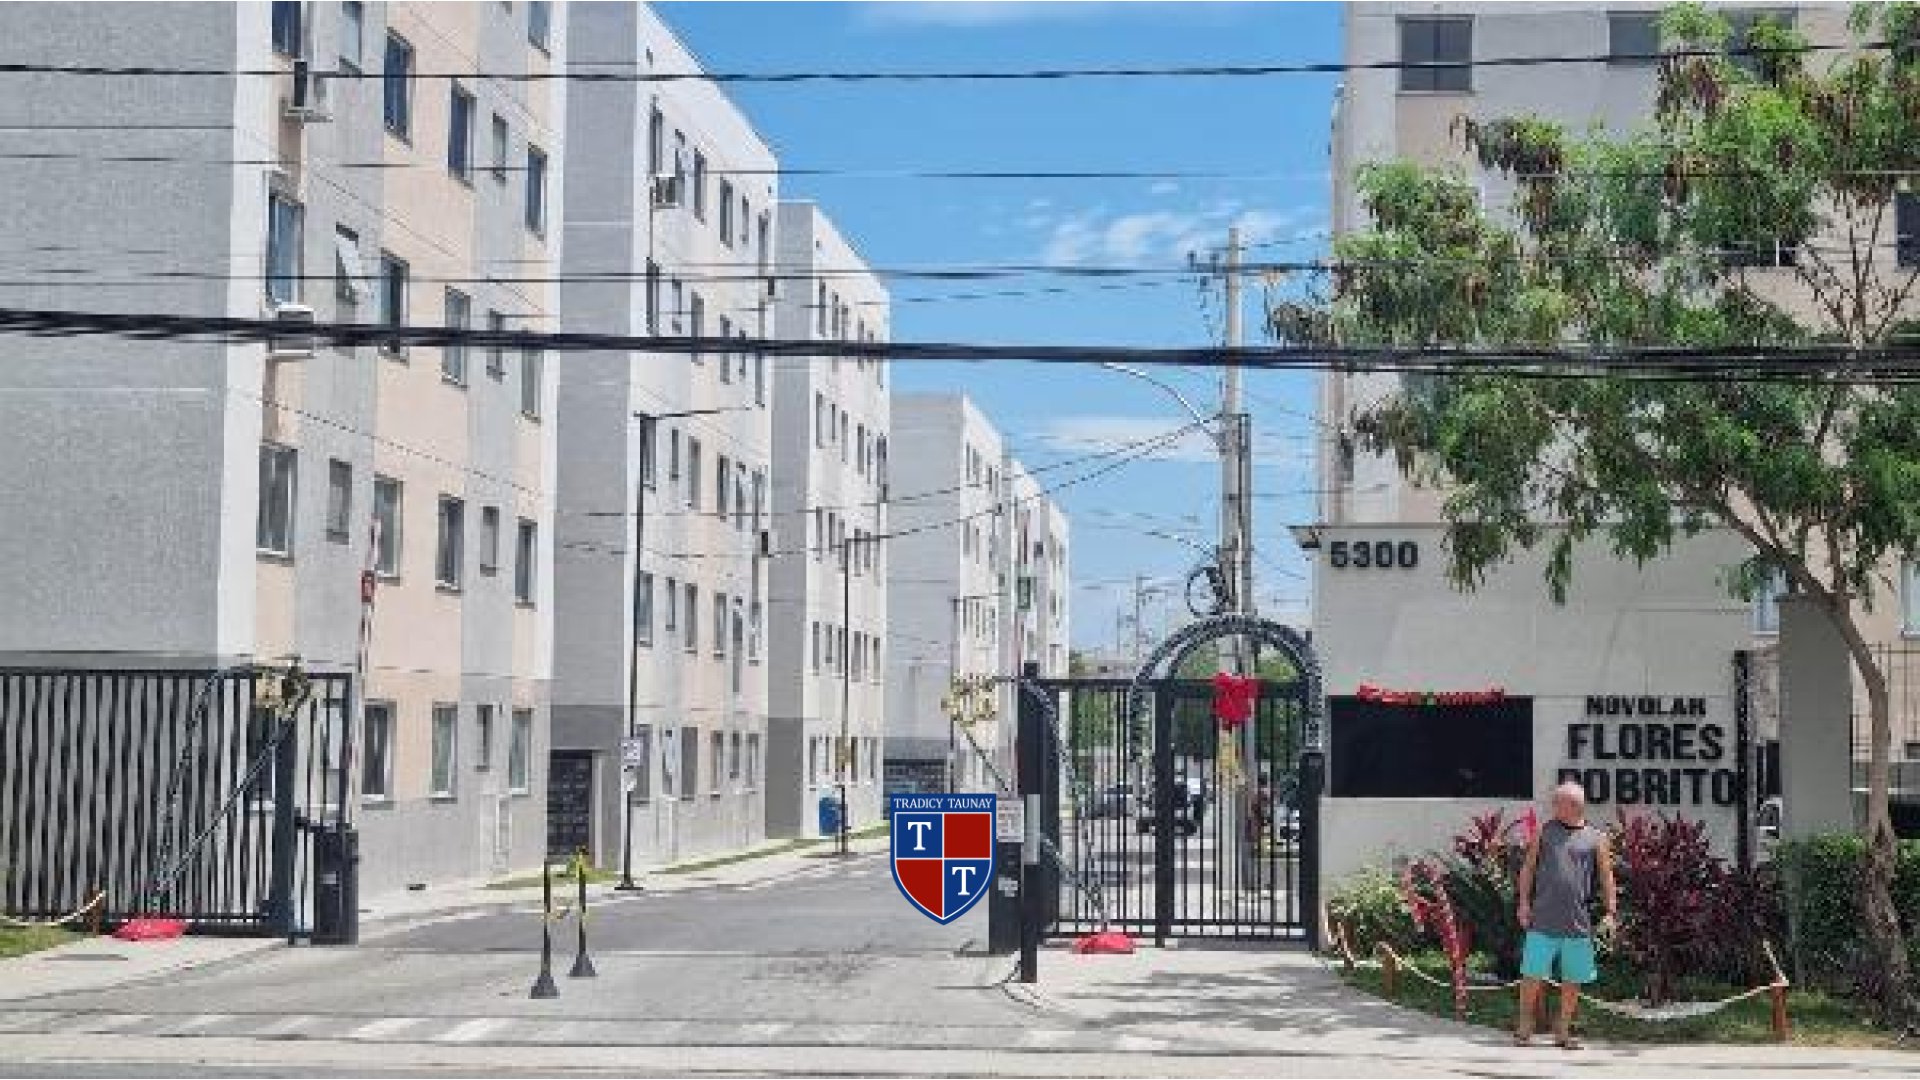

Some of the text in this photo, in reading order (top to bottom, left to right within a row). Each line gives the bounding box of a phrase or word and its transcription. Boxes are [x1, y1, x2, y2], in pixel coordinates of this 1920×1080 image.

[1331, 541, 1418, 568] 5300
[1586, 695, 1706, 715] NOVOLAR
[1567, 723, 1724, 760] FLORES
